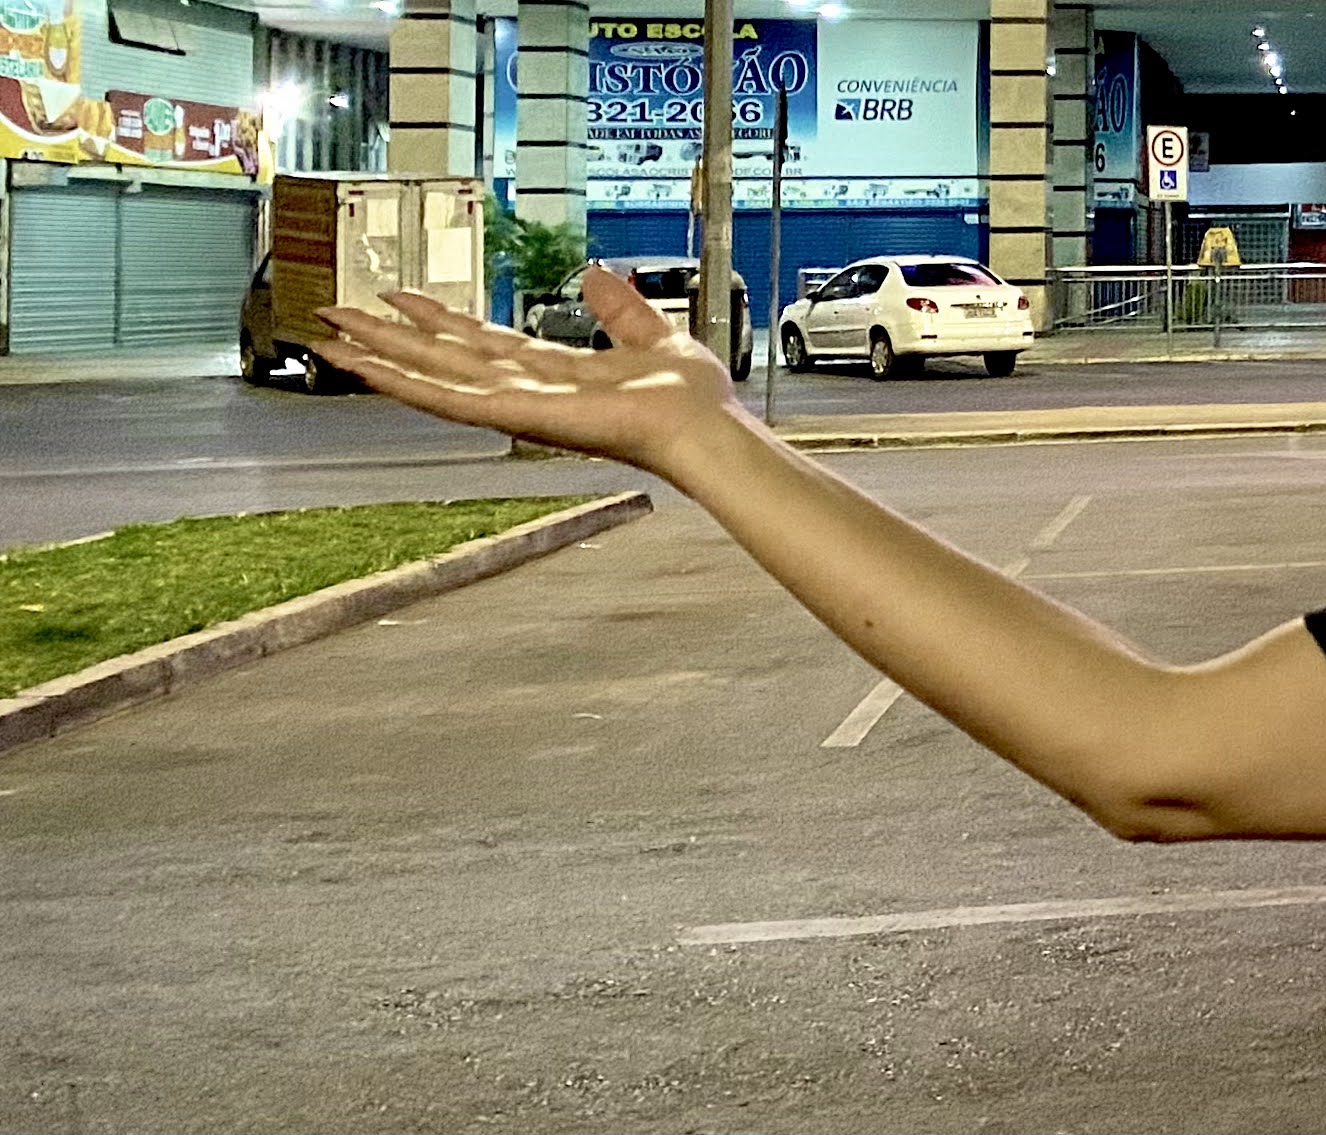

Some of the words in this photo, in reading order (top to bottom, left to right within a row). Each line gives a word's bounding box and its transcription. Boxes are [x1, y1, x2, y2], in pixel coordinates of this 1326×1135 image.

[587, 22, 638, 39] UTO
[646, 22, 759, 40] ESCA
[837, 77, 958, 93] CONVENIÊNCIA
[862, 98, 914, 121] BRB
[1162, 137, 1174, 159] E
